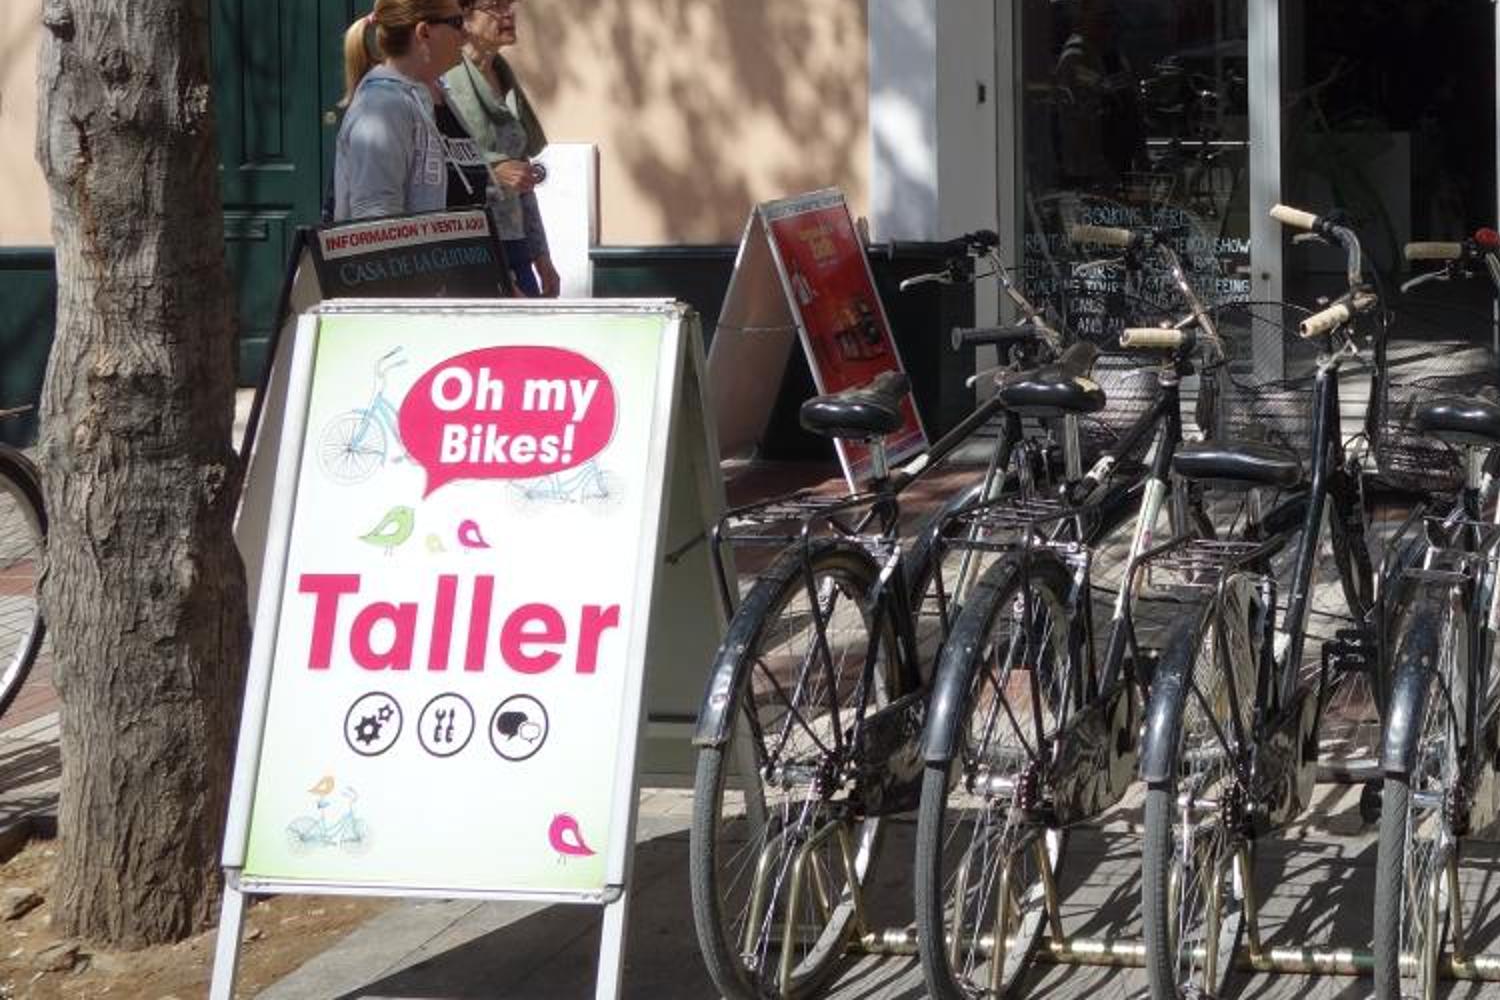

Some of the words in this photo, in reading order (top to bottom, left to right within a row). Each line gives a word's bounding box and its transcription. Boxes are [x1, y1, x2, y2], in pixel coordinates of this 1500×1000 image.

[325, 223, 419, 252] INFORMACION
[421, 224, 428, 236] Y
[431, 219, 463, 234] VENTA
[429, 367, 506, 413] Oh
[522, 373, 600, 423] my
[439, 424, 575, 465] Bikes!
[297, 572, 622, 677] Taller
